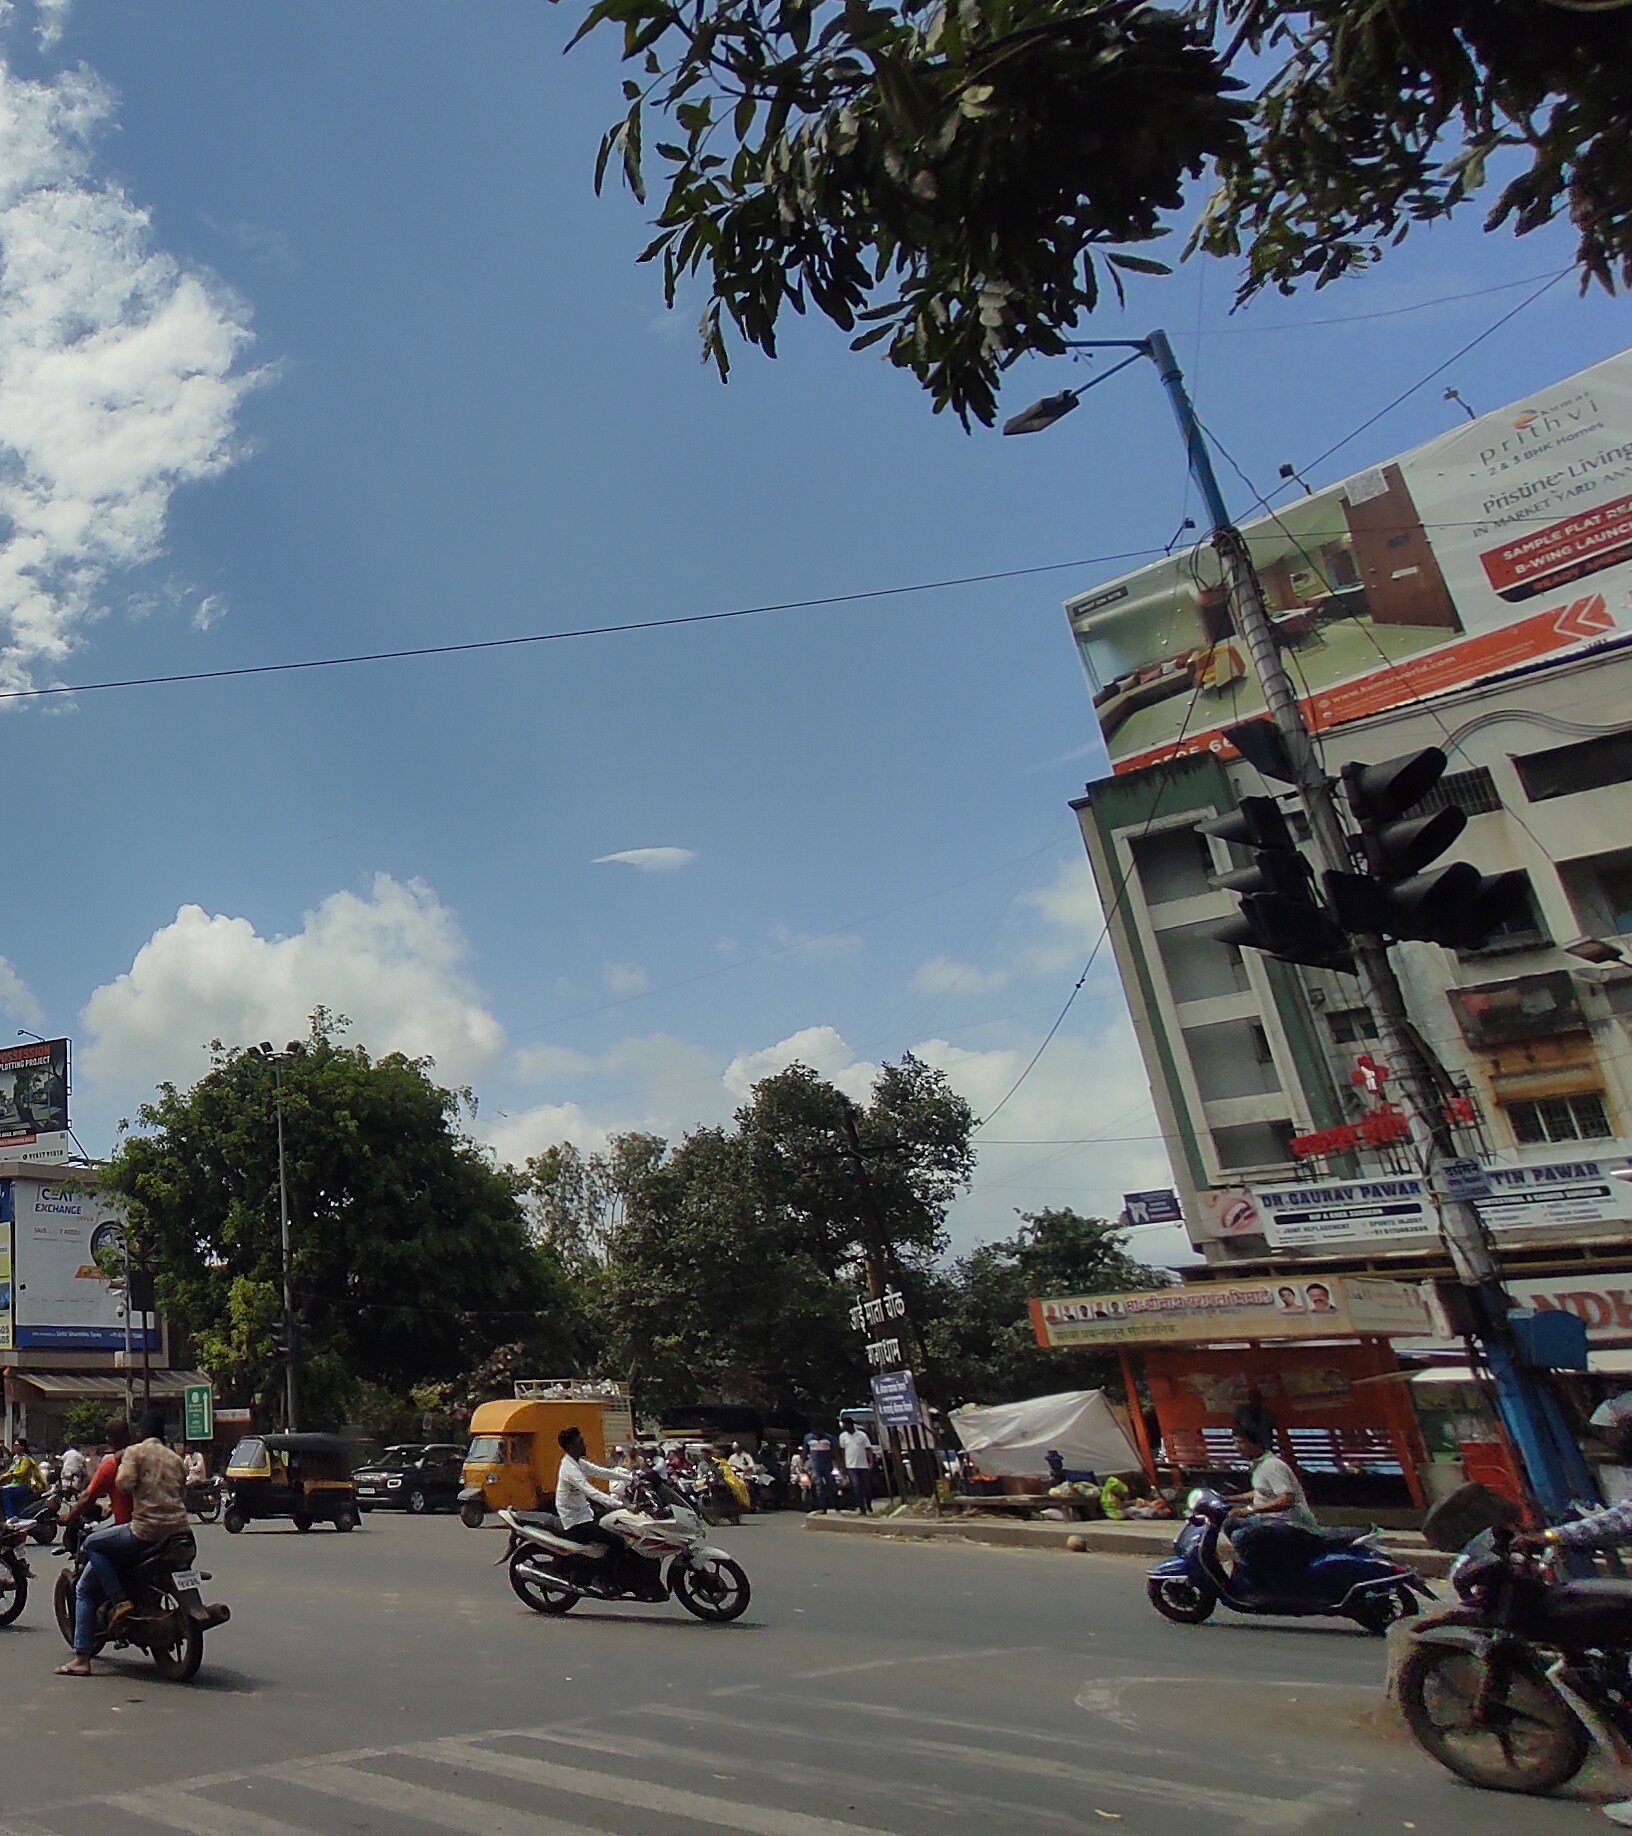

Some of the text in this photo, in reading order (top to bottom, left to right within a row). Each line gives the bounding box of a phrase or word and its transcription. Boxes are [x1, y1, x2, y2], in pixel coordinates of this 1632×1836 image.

[1479, 400, 1598, 466] prithvi
[1488, 467, 1498, 476] 2
[1512, 455, 1521, 465] 3
[1524, 442, 1554, 460] BHK
[1556, 421, 1605, 446] Homes
[1472, 527, 1489, 538] IN
[1494, 497, 1550, 529] MARKET
[1555, 481, 1597, 502] YARD
[1483, 472, 1564, 514] Pristine
[1502, 530, 1562, 561] SAMPLE
[1565, 515, 1601, 536] FLAT
[1515, 545, 1573, 573] B-WING
[1575, 522, 1632, 550] LAUNC
[26, 1055, 51, 1068] PROJECT
[1359, 1178, 1422, 1198] PAWAR
[1531, 1162, 1600, 1182] PAWAR
[35, 1203, 82, 1215] EXCHANGE
